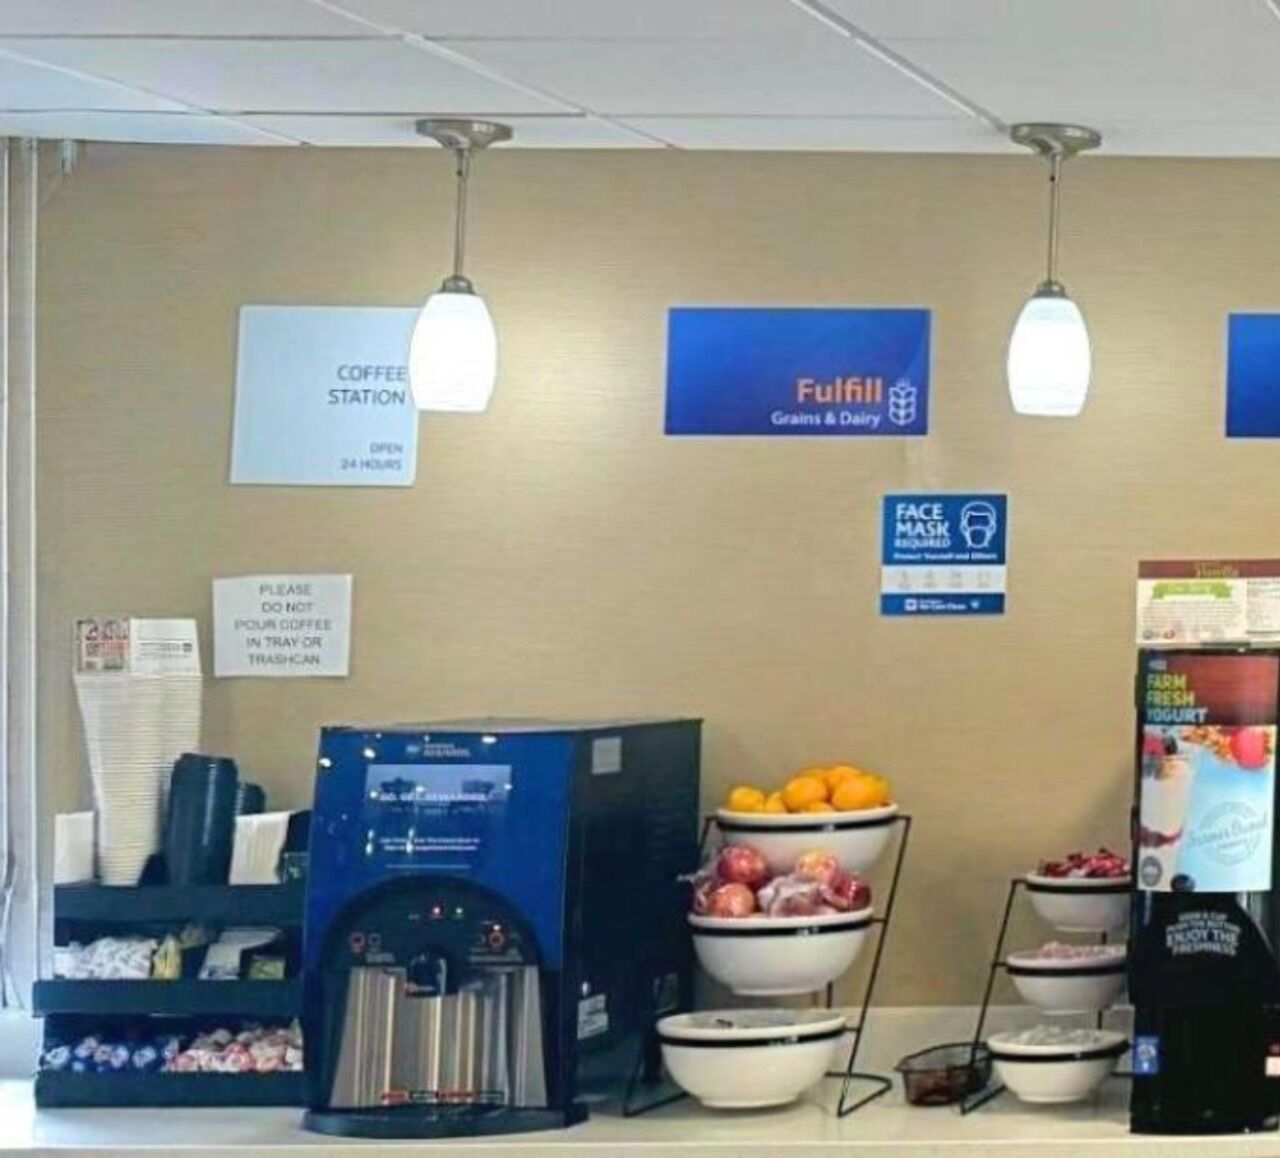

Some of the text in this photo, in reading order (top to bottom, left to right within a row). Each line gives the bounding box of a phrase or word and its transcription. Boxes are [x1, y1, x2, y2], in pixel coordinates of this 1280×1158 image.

[337, 365, 407, 381] COFFEE
[328, 388, 406, 405] STATION
[796, 377, 882, 403] Fulfill
[771, 411, 881, 428] Grains & Dairy
[369, 442, 403, 454] OPEN
[341, 459, 402, 471] 24 HOURS
[896, 503, 944, 519] FACE
[895, 521, 951, 537] MASK
[894, 538, 952, 550] REQUIRED
[259, 584, 313, 596] PLEASE
[261, 602, 314, 613] DO NOT
[234, 620, 332, 631] POUR COFFEE
[246, 636, 322, 648] IN TRAY OR
[249, 653, 320, 666] TRASHCAN
[1146, 673, 1187, 689] FARM
[1146, 690, 1196, 706] FRESH
[1147, 706, 1209, 723] YOGURT
[1166, 929, 1239, 947] ENJOY THE
